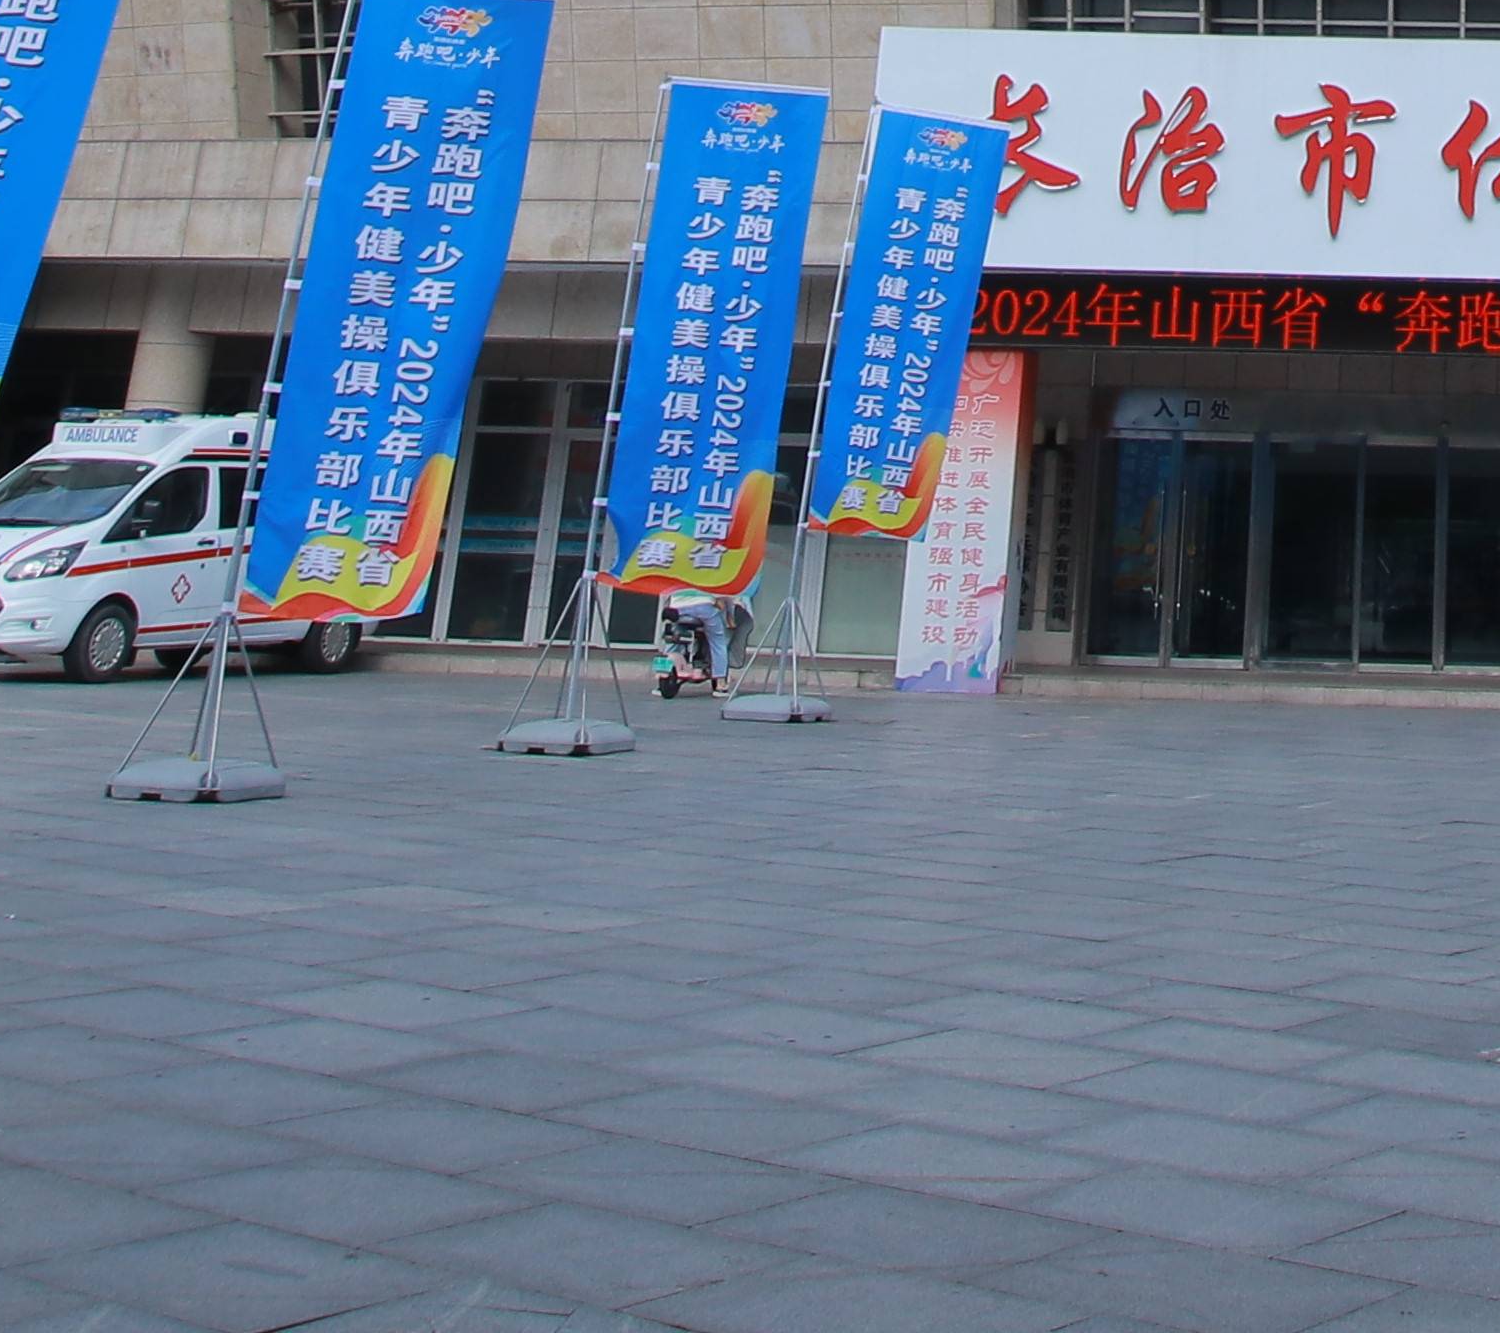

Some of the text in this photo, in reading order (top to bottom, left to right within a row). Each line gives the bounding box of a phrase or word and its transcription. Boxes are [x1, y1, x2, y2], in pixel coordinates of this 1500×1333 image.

[394, 36, 501, 70] 奔跑吧·少年
[64, 425, 139, 444] AMBULANCE
[295, 95, 429, 585] 青少年健美操俱乐部比赛
[636, 175, 731, 569] 青少年健美操俱乐部比赛
[840, 187, 928, 512] 青少年健美操俱乐部比赛
[1153, 397, 1232, 421] 入口处
[952, 395, 1001, 647] 广泛开展全民健身活动
